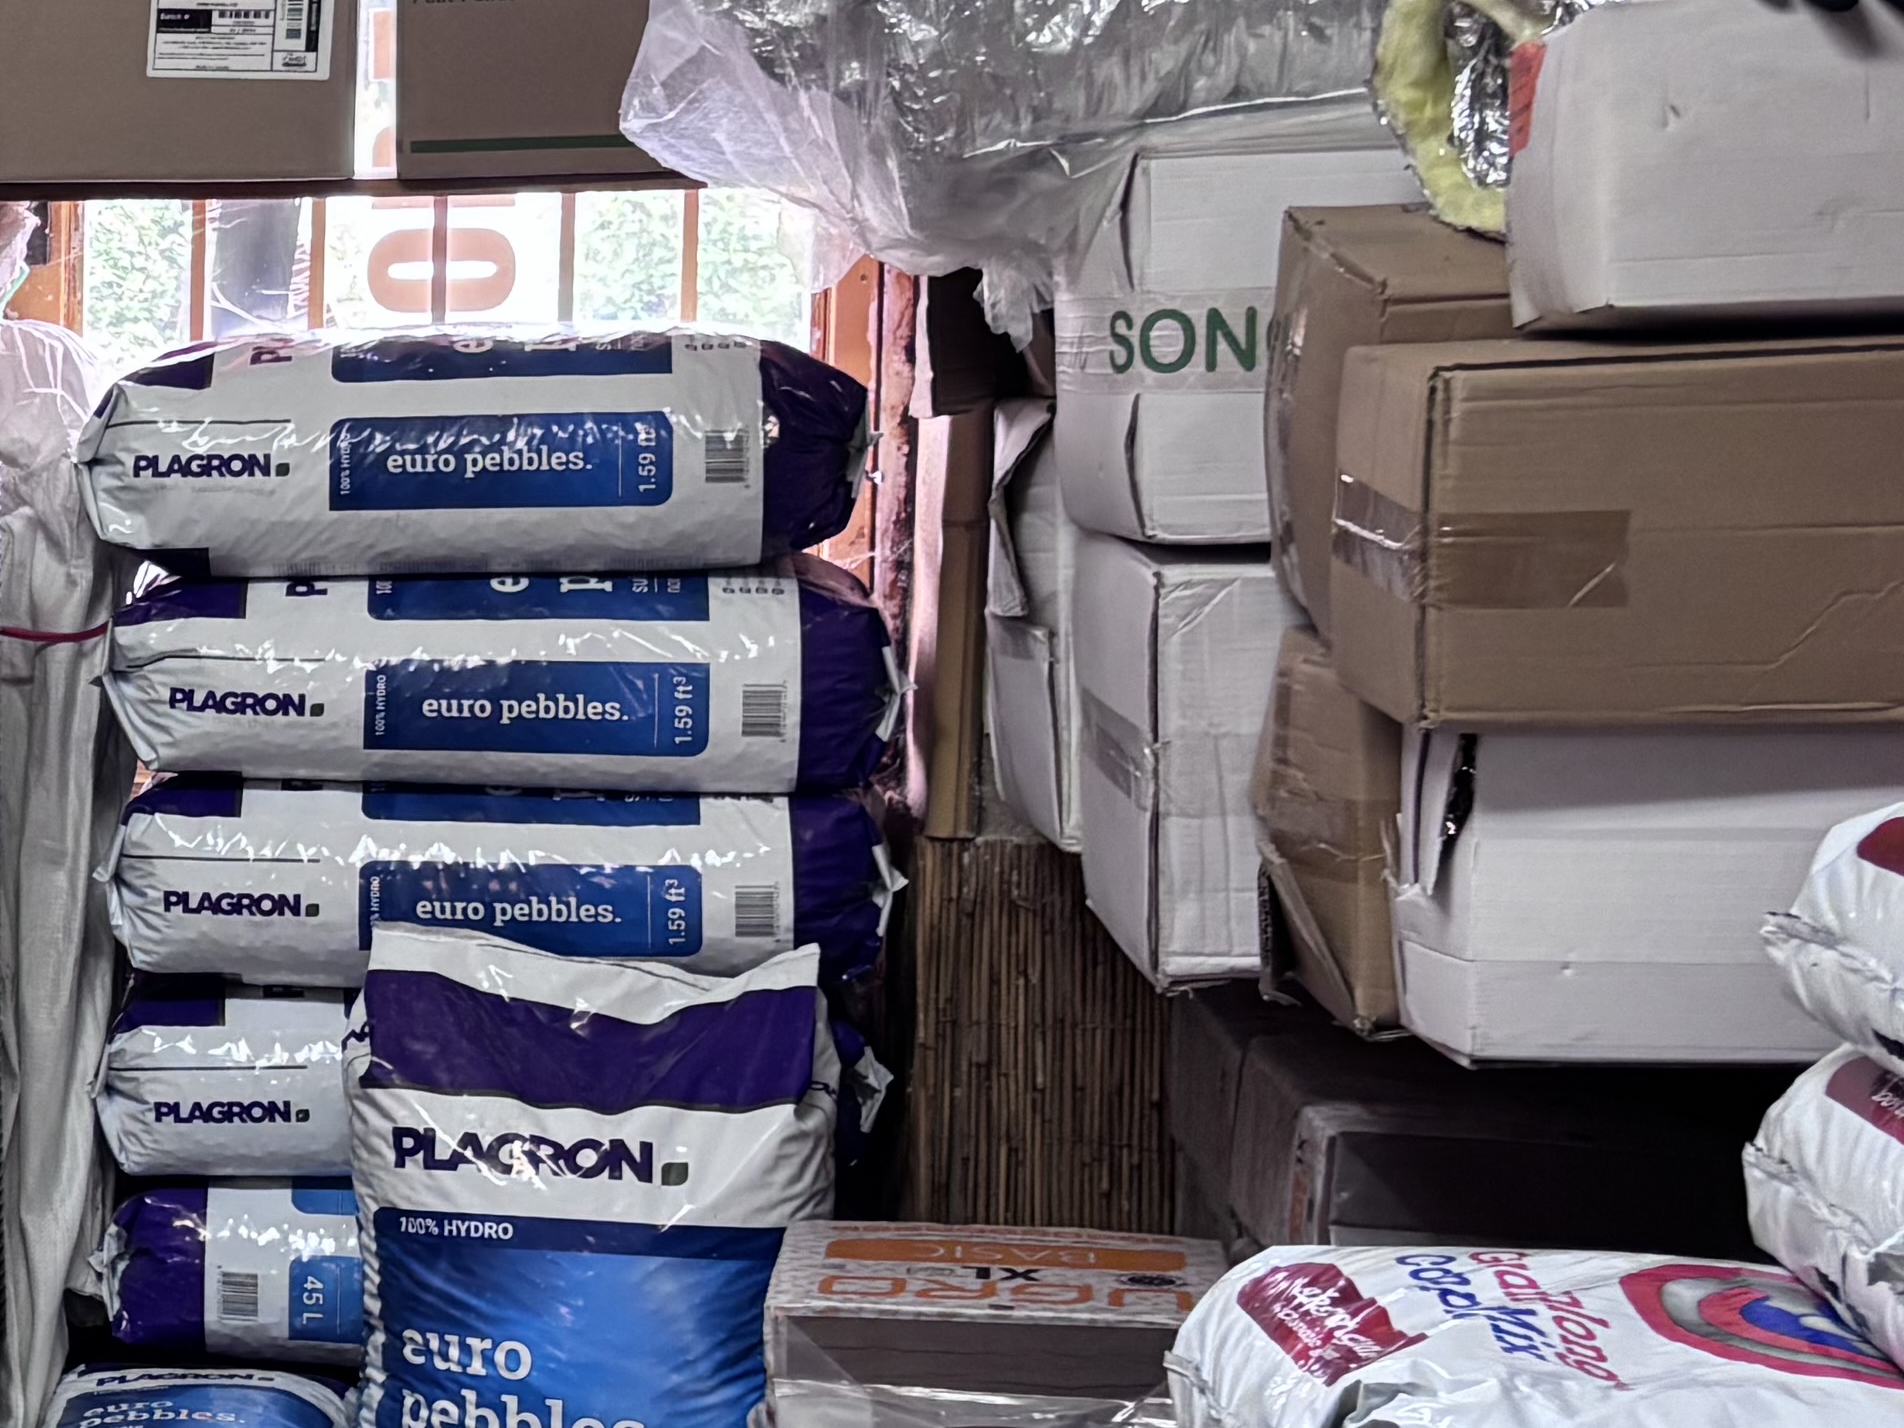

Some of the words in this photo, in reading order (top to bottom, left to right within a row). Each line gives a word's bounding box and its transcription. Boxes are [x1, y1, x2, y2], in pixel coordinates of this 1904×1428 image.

[1107, 304, 1276, 375] SON
[133, 452, 272, 479] PLAGRON
[386, 448, 455, 474] euro
[463, 444, 593, 477] pebbles.
[168, 686, 306, 717] PLAGRON
[421, 696, 493, 719] euro
[499, 691, 629, 724] pebbles.
[673, 705, 692, 745] 1.59
[163, 891, 302, 918] PLAGRON
[414, 897, 486, 922] euro
[492, 896, 622, 926] pebbles.
[667, 905, 686, 947] 1.59
[154, 1101, 292, 1125] PLAGRON
[391, 1125, 654, 1184] PLAGRON
[399, 1216, 439, 1237] 100%
[443, 1220, 515, 1241] HYDRO
[915, 1241, 1096, 1265] BASIC
[961, 1265, 1042, 1282] XL
[301, 1274, 325, 1305] 45
[301, 1307, 324, 1325] L
[401, 1328, 533, 1381] euro
[83, 1399, 174, 1417] euro
